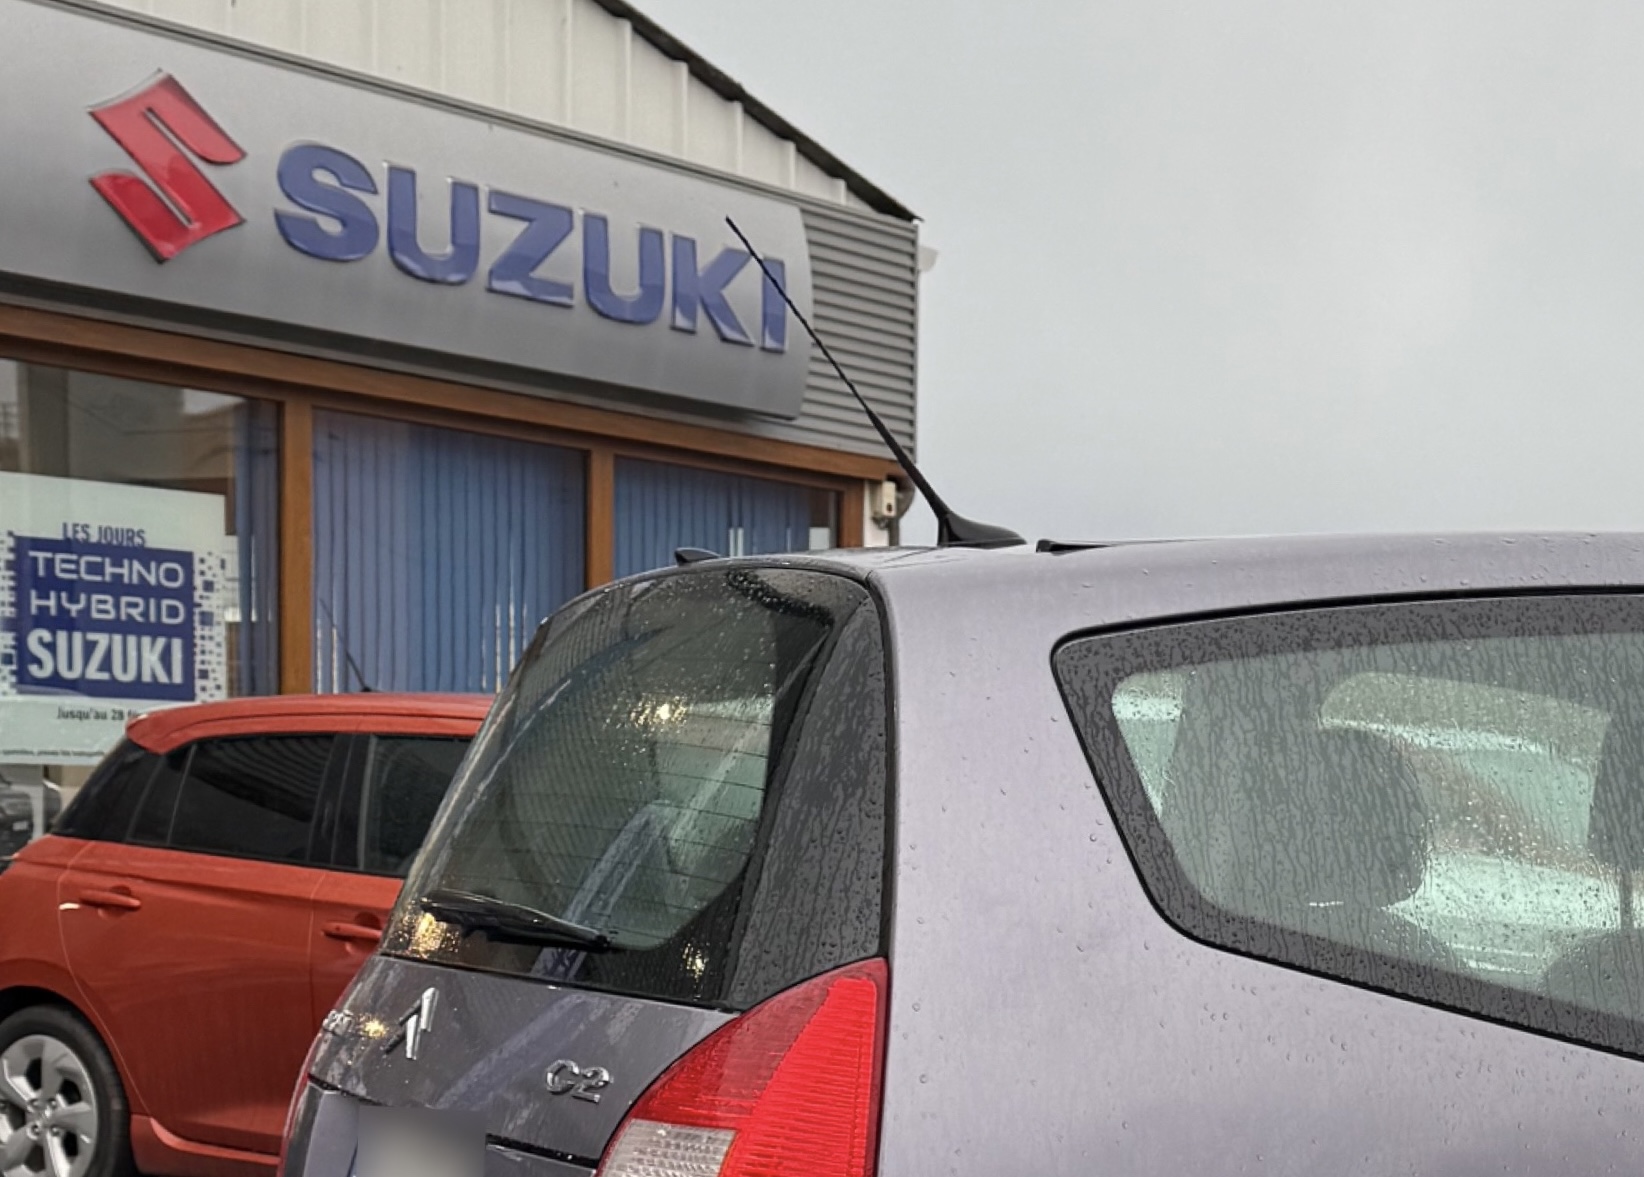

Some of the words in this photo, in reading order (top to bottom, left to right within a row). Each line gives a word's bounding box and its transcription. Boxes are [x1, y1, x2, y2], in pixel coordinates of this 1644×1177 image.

[274, 141, 787, 352] SUZUKI
[62, 522, 90, 542] LES
[94, 526, 146, 548] JOURS
[28, 551, 185, 588] TECHNO
[30, 590, 185, 624] HYBRID
[27, 628, 183, 684] SUZUKI
[546, 1059, 610, 1104] C2
